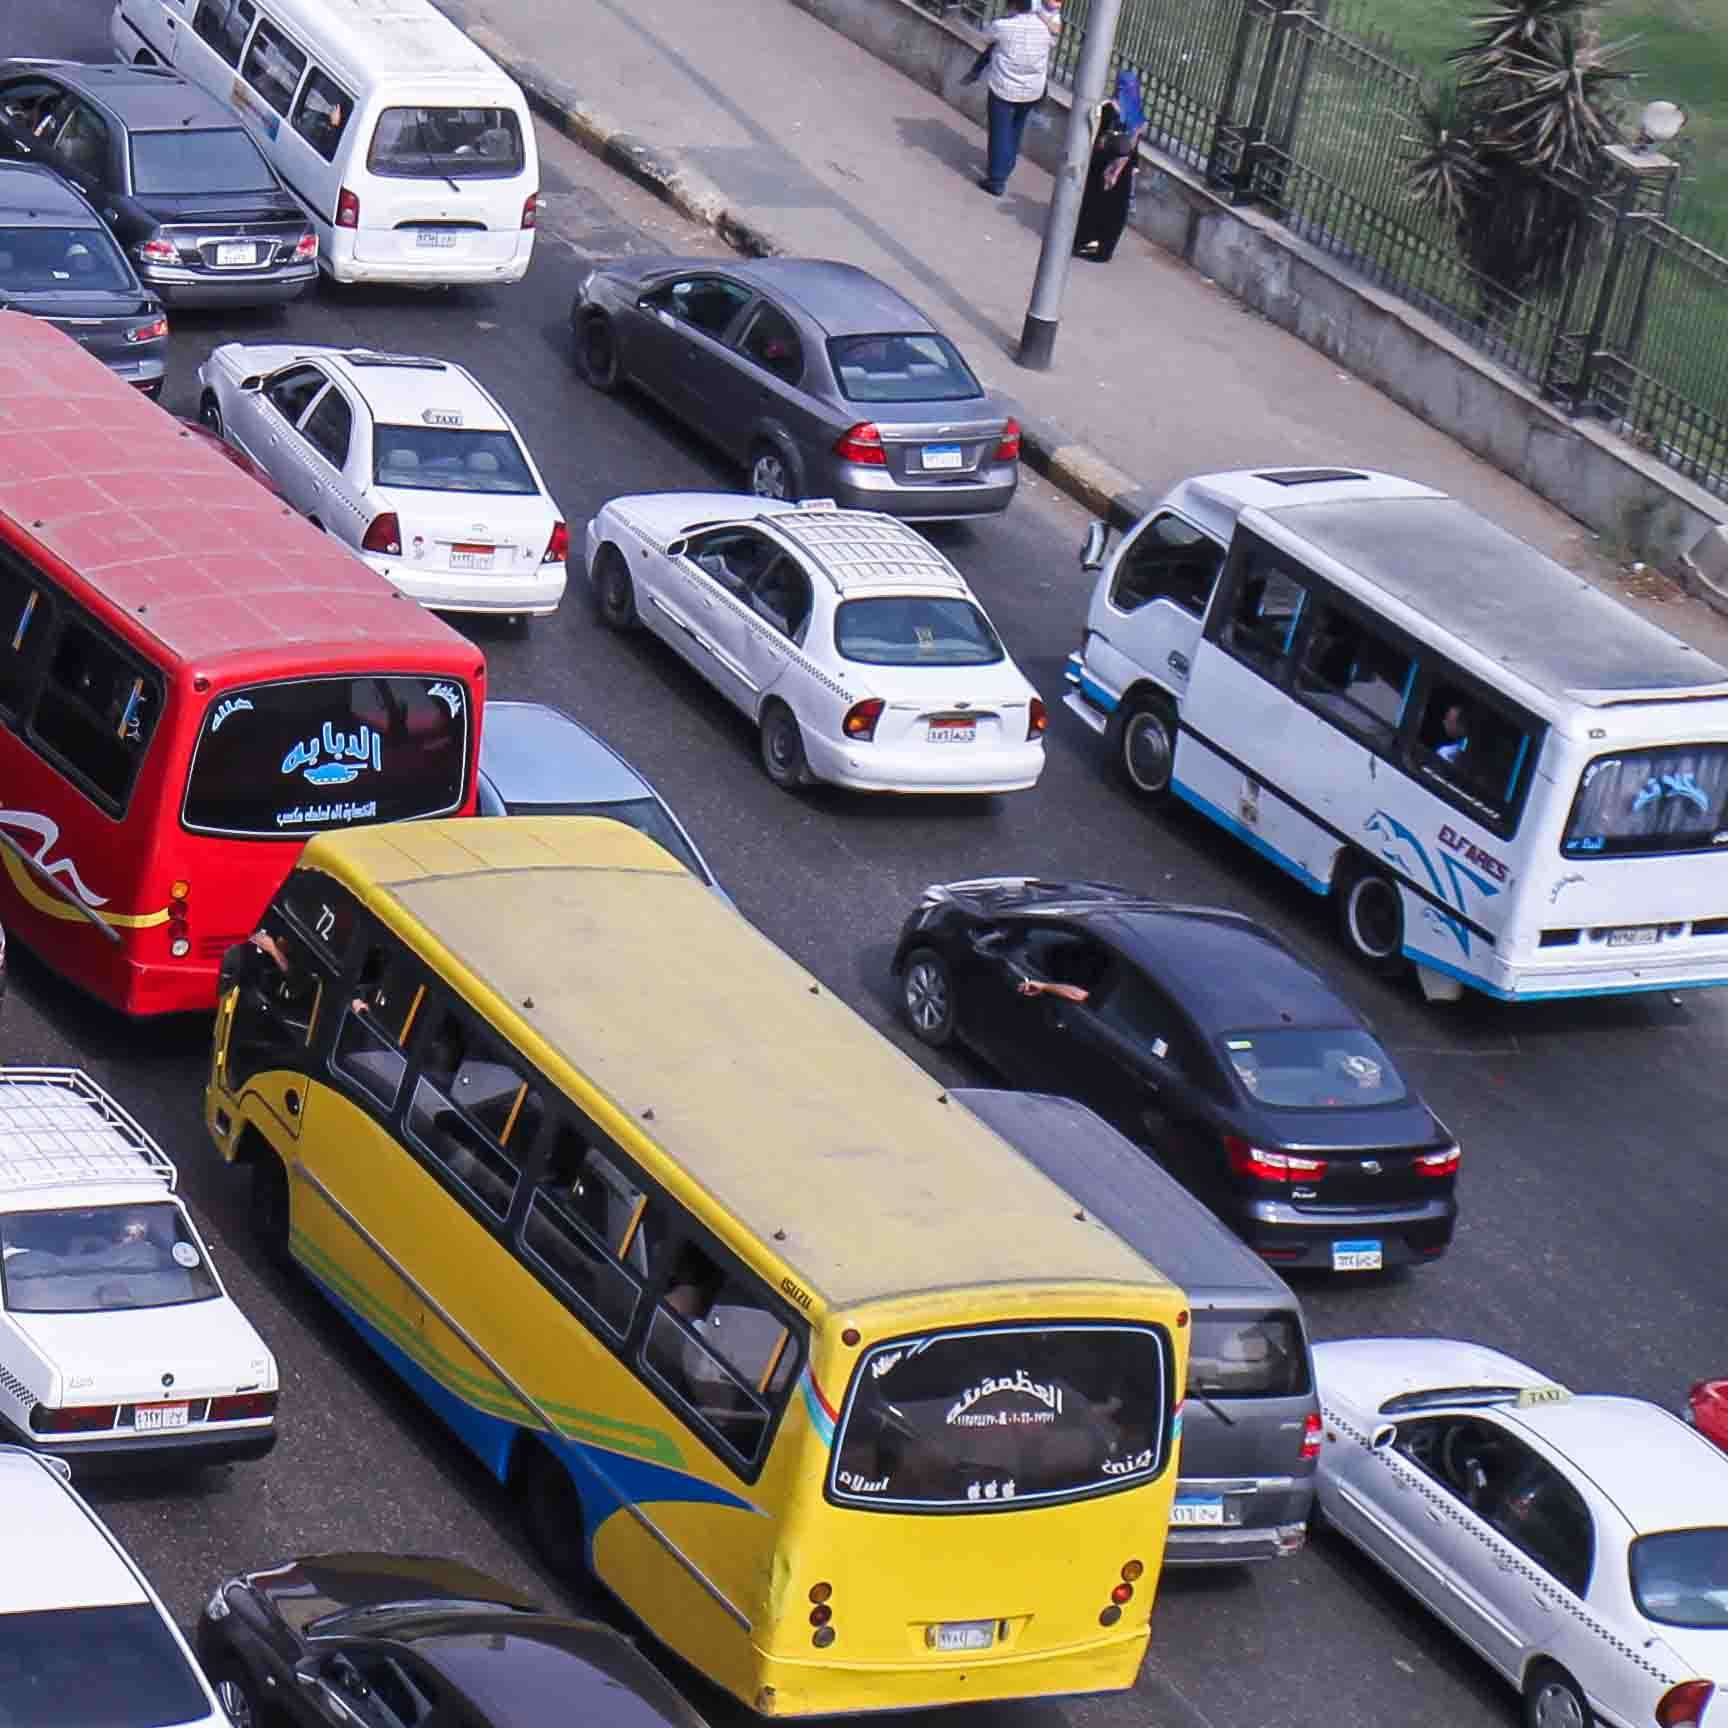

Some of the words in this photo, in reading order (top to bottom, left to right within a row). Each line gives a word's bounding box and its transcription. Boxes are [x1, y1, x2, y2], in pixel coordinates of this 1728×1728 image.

[433, 415, 461, 425] TAXI
[1437, 823, 1511, 883] ELFARES
[315, 903, 336, 942] 72
[1527, 1390, 1561, 1403] TAXI
